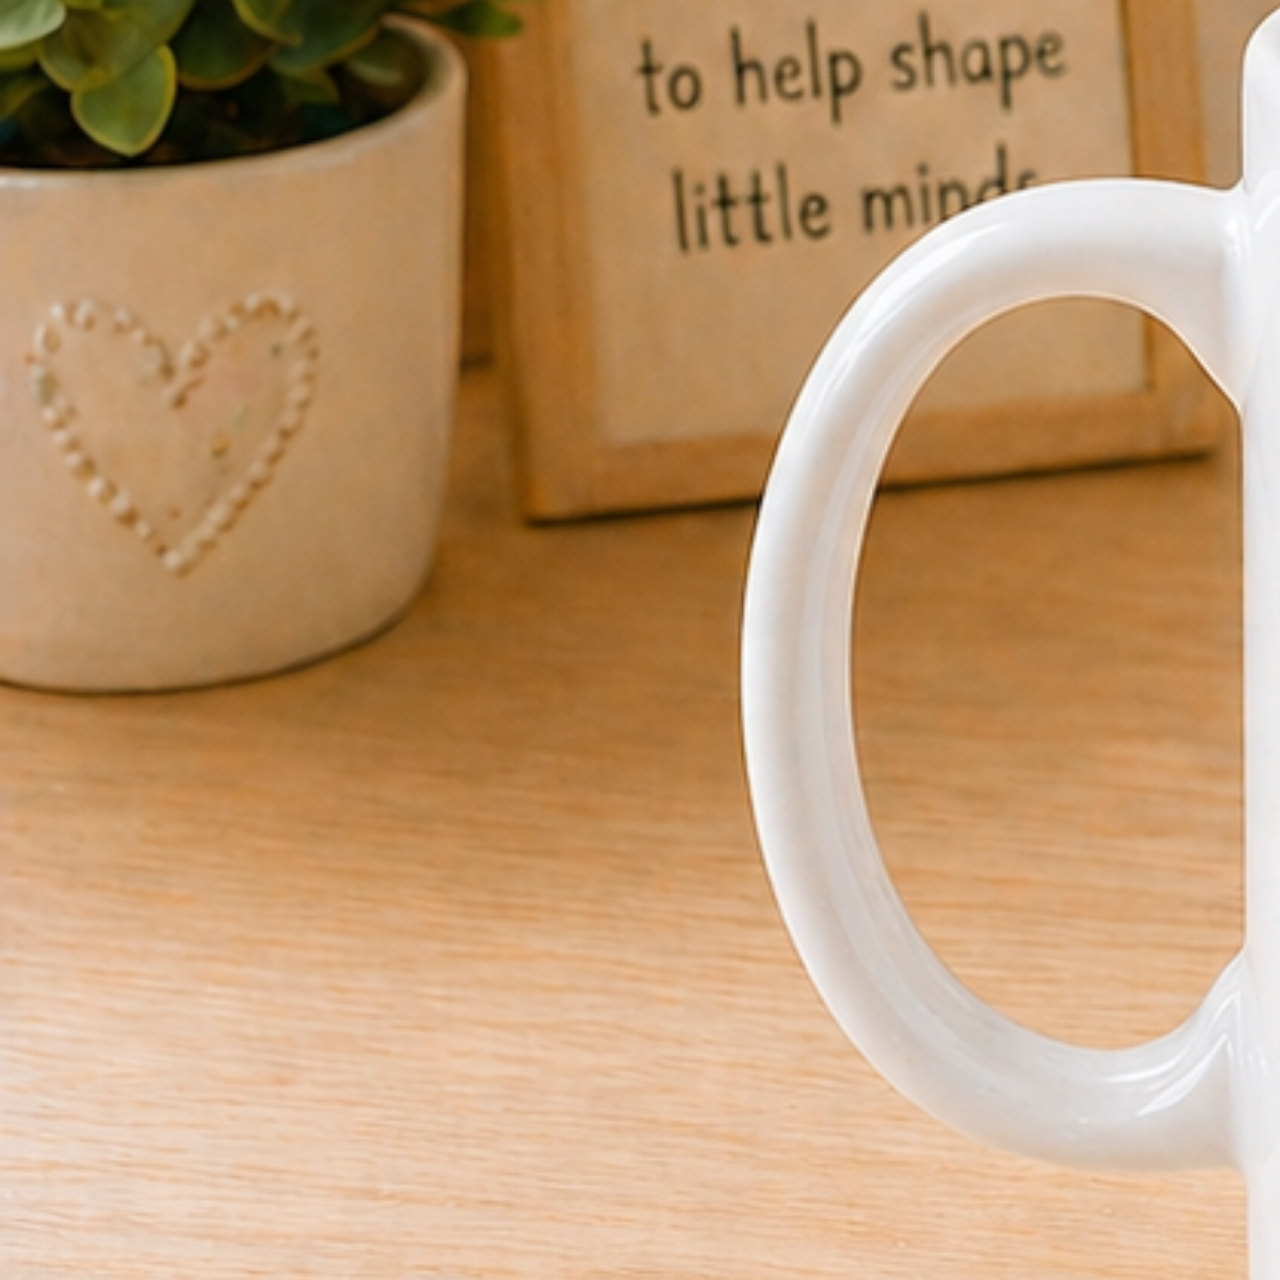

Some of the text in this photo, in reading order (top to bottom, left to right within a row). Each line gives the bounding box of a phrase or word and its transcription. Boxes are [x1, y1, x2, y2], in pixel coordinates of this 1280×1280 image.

[637, 11, 1066, 124] to help shape
[671, 163, 832, 253] little
